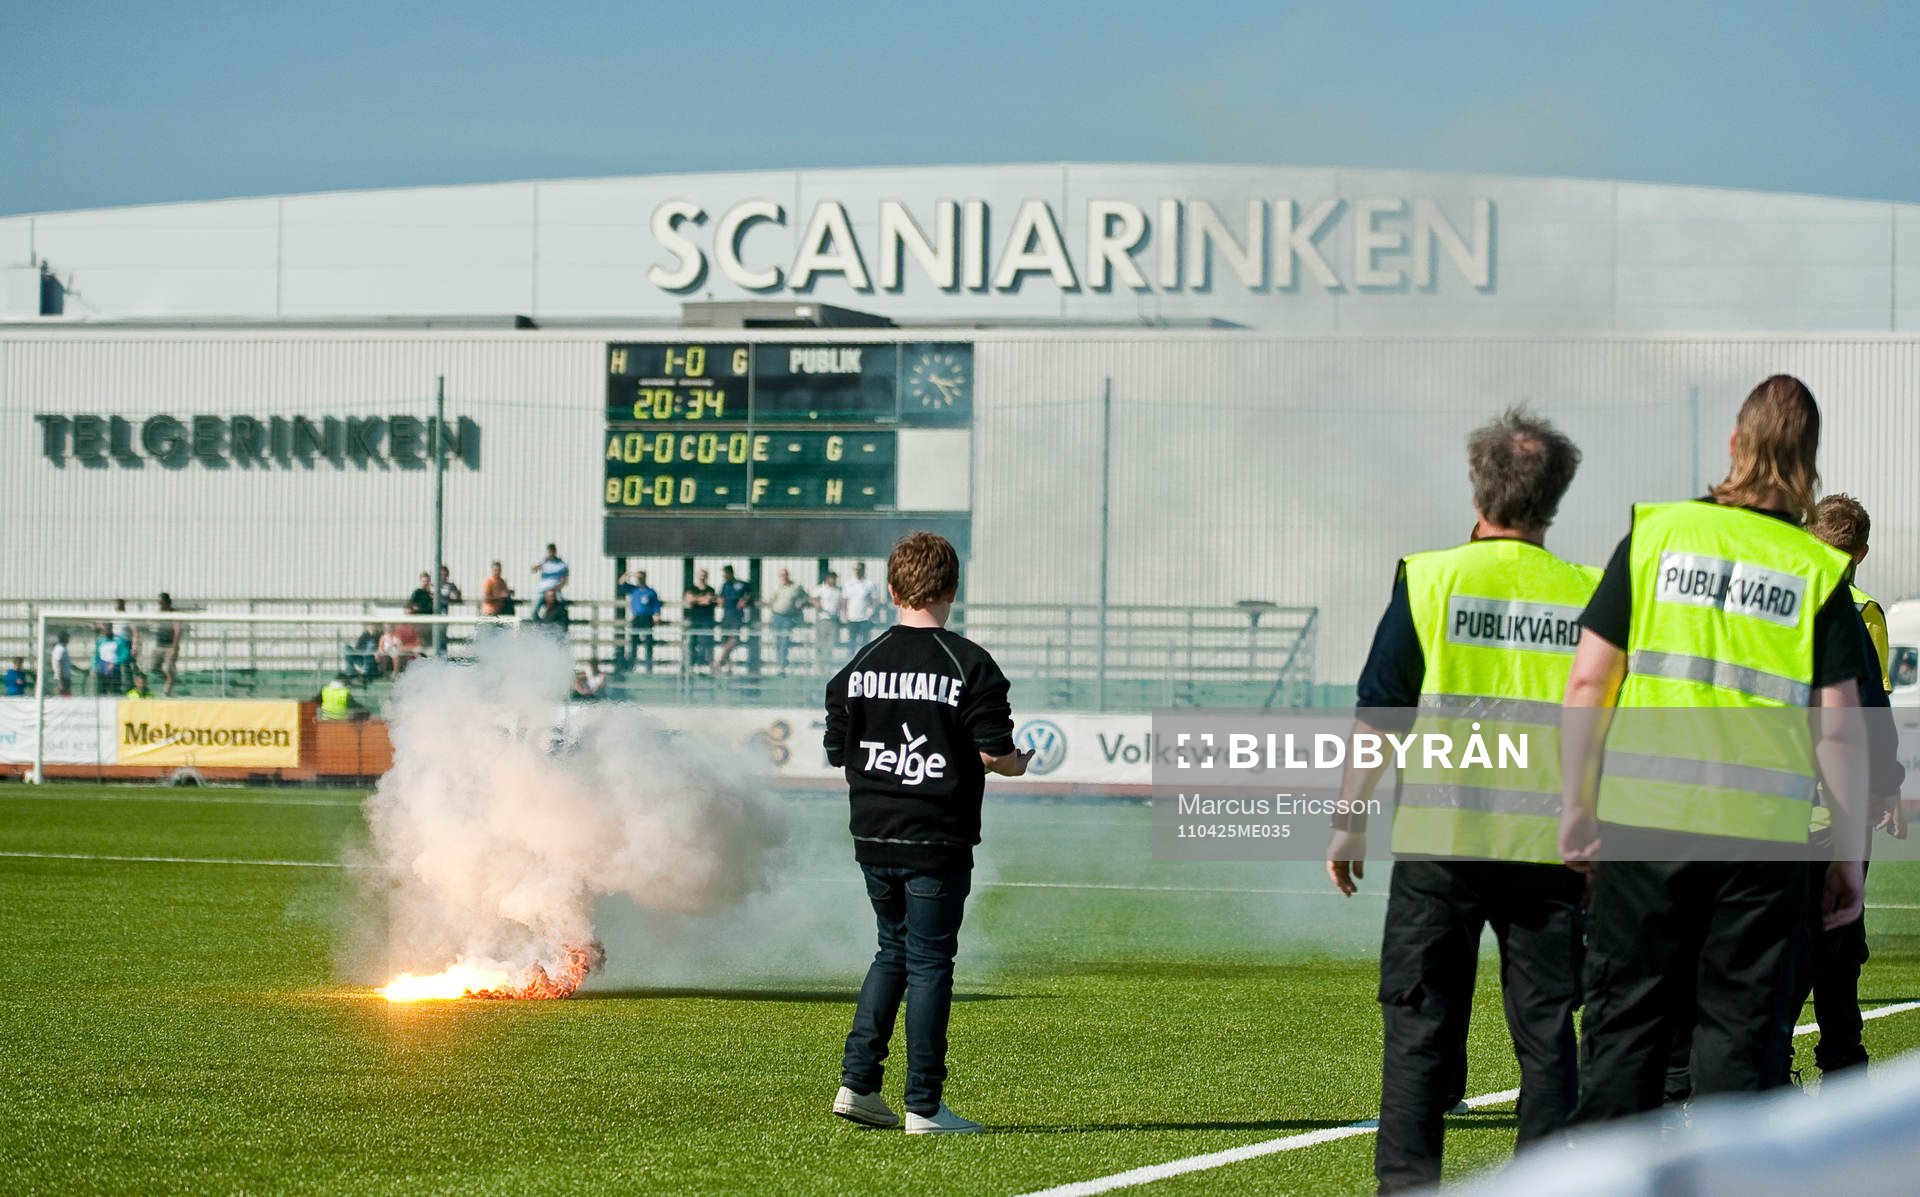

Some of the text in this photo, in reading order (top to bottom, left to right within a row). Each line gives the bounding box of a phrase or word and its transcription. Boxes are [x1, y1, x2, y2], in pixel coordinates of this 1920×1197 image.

[647, 198, 1497, 293] SCANIARINKEN
[610, 347, 748, 376] H 1-0 G
[789, 348, 862, 374] PUBLIK
[633, 389, 725, 420] 20:34
[34, 414, 480, 469] TELGERINKEN
[848, 671, 962, 707] BOLLKALLE
[123, 721, 290, 747] Mekonomen
[859, 738, 947, 785] Telge
